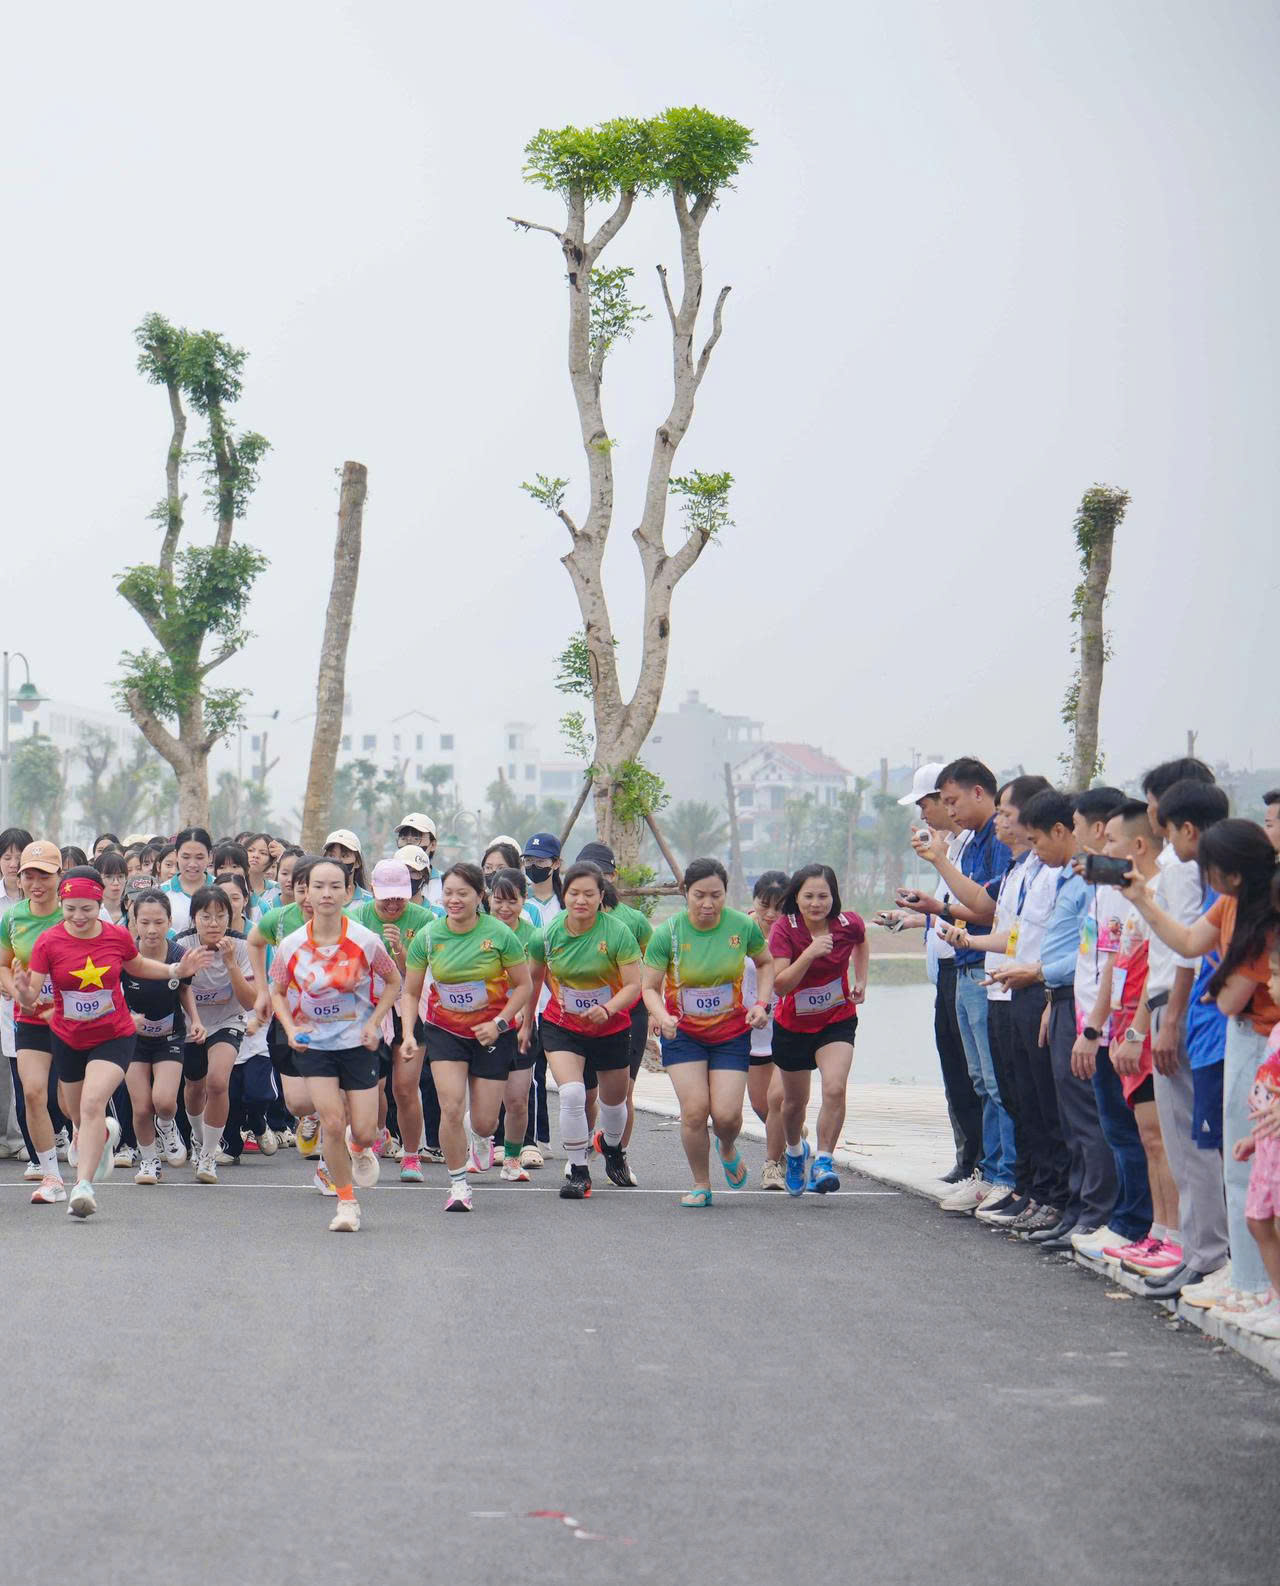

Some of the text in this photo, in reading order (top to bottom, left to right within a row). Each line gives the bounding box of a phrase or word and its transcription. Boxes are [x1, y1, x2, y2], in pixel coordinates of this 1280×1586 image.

[195, 992, 219, 1001] 027
[449, 993, 473, 1004] 035
[808, 992, 831, 1005] 030
[75, 1001, 100, 1012] 099
[575, 999, 599, 1008] 063
[696, 997, 720, 1008] 036
[314, 1004, 340, 1015] 055
